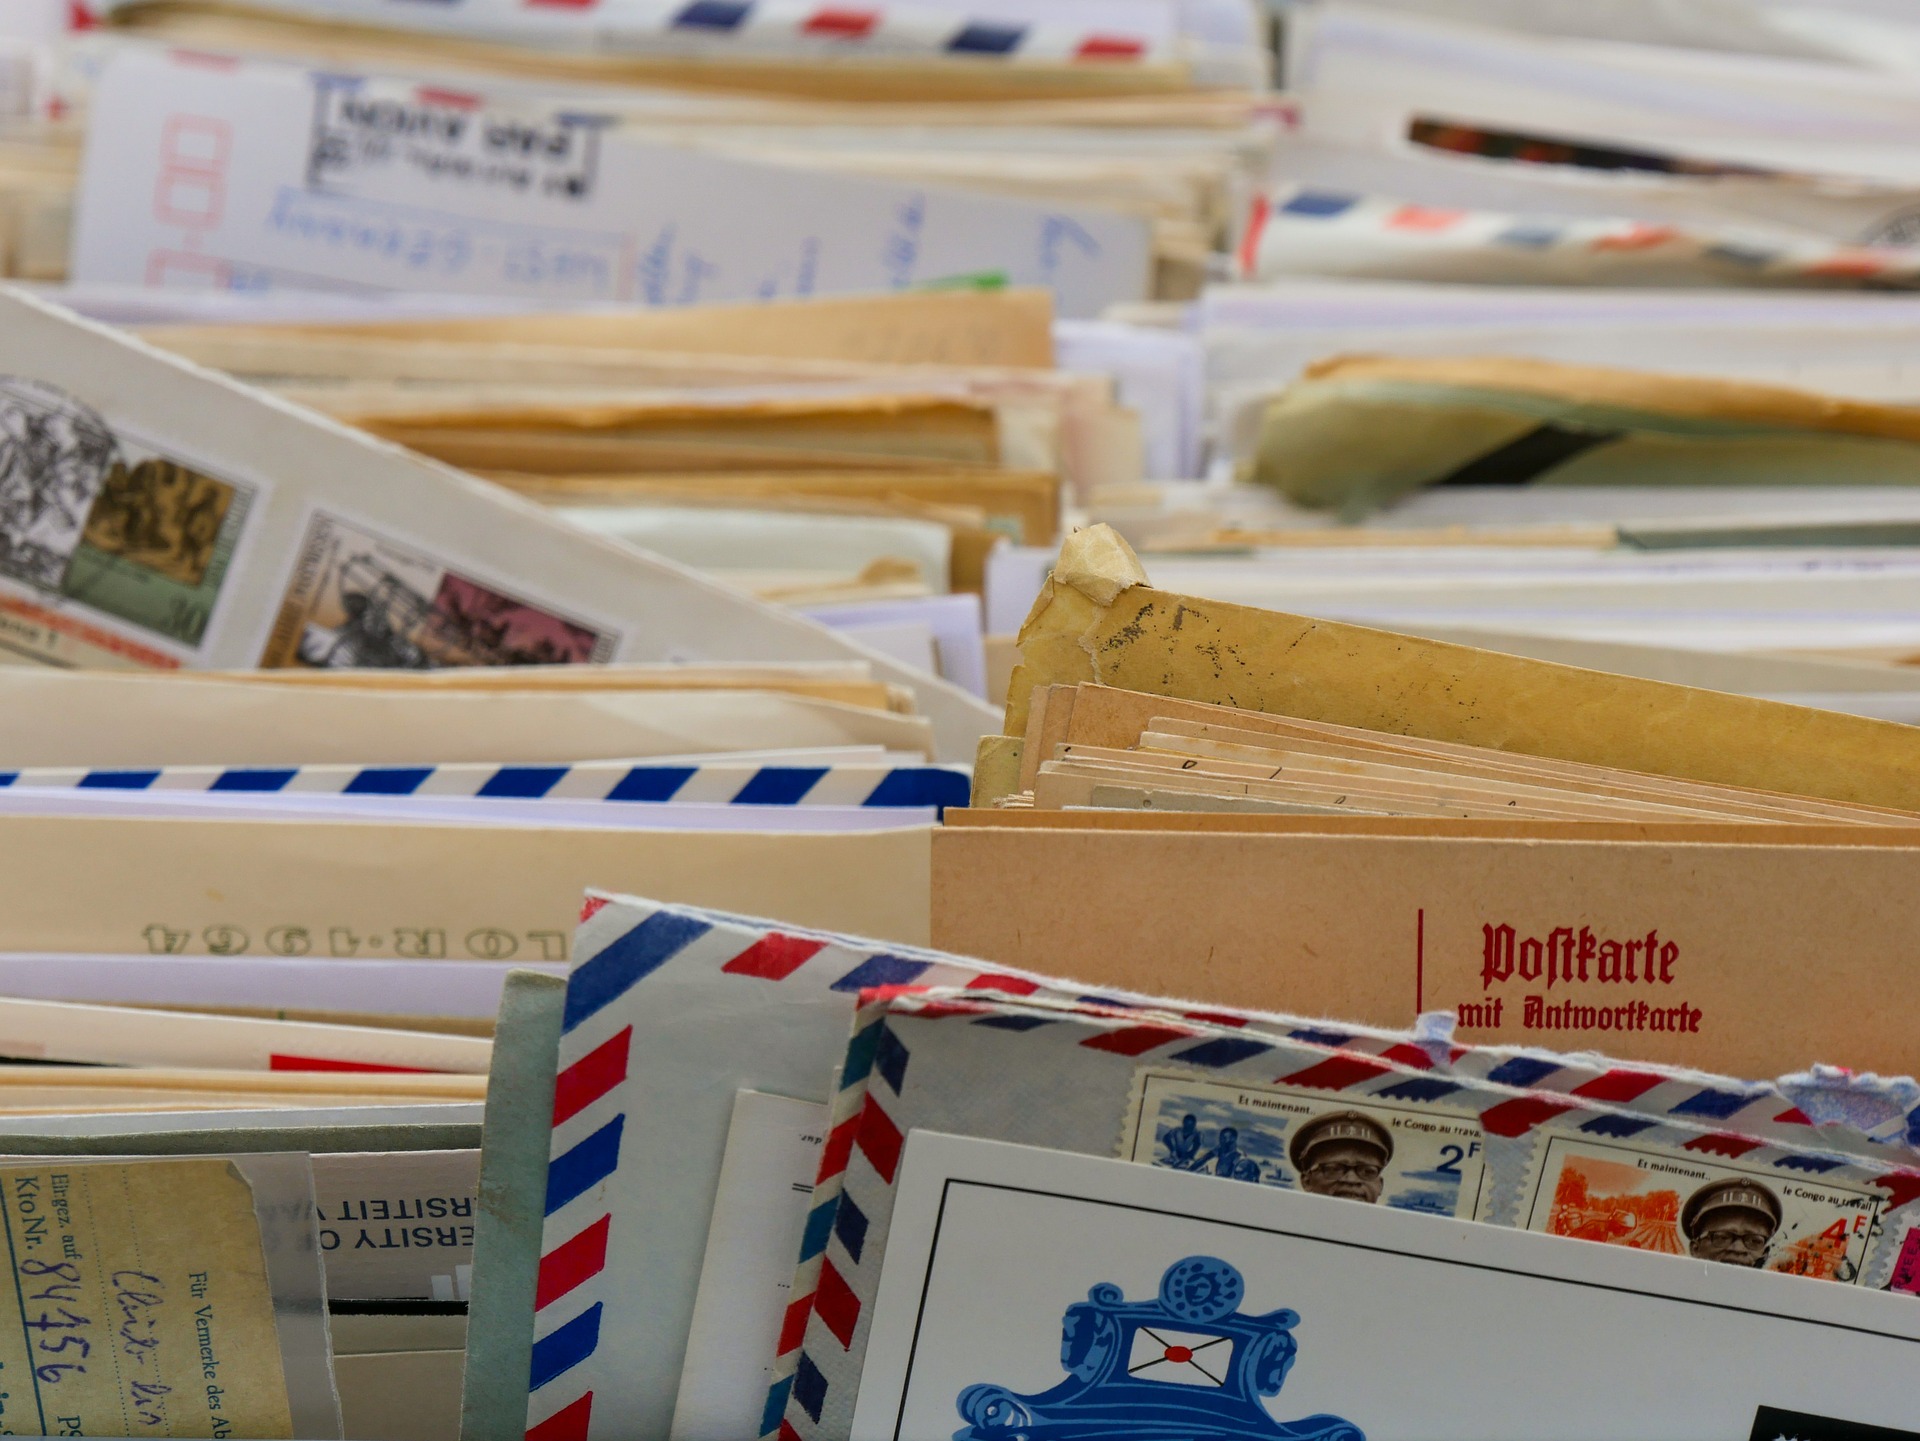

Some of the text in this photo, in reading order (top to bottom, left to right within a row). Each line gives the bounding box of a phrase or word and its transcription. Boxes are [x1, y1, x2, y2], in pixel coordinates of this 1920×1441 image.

[1458, 995, 1703, 1034] mit Antwortkarte
[1238, 1094, 1251, 1107] Et
[1392, 1116, 1482, 1139] le Congo au trava
[1637, 1158, 1650, 1171] Et
[337, 1197, 477, 1221] RSITEIT
[1783, 1185, 1873, 1213] le Congo au travail
[61, 1235, 83, 1260] auf
[354, 1226, 475, 1250] ERSITY
[189, 1272, 208, 1299] Für
[194, 1304, 220, 1380] Vermerke
[206, 1385, 225, 1411] des
